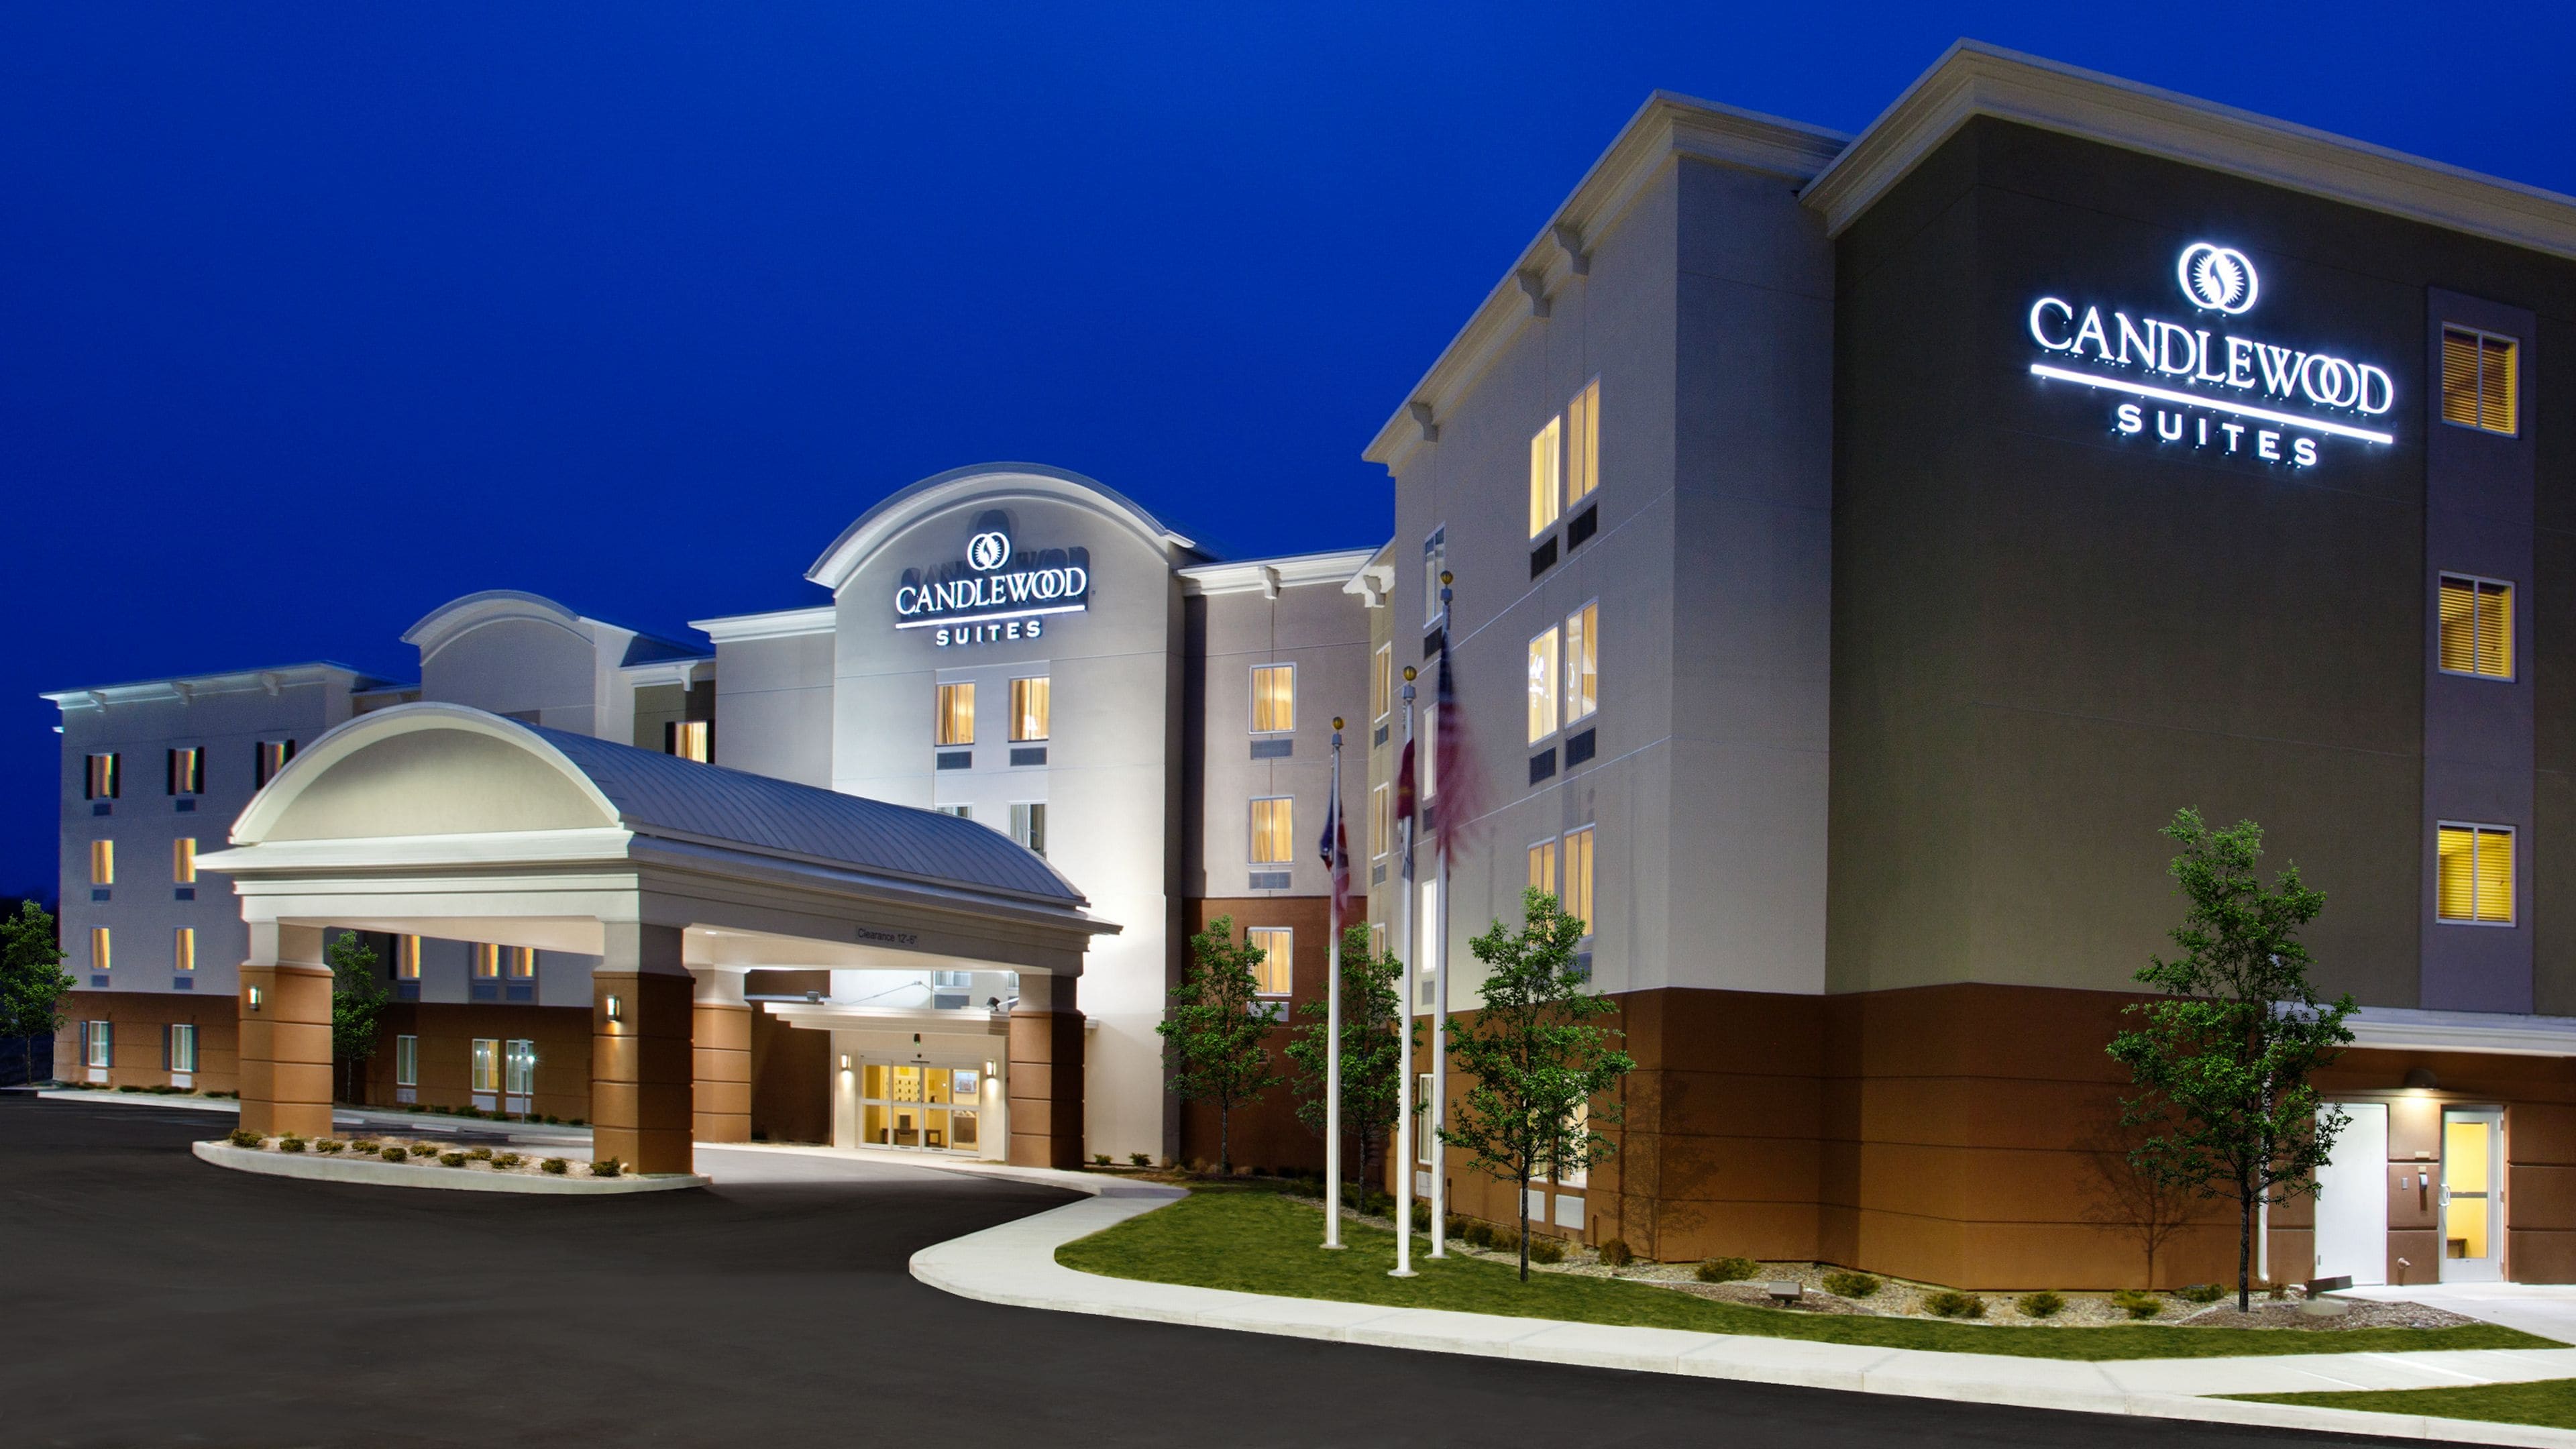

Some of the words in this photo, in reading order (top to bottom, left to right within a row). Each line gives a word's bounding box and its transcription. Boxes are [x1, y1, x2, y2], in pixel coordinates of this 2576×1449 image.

[2030, 297, 2393, 414] CANDLEWOOD
[2117, 404, 2317, 466] SUITES
[896, 567, 1087, 614] CANDLEWOOD
[936, 621, 1040, 646] SUITES
[858, 928, 895, 942] Clearance
